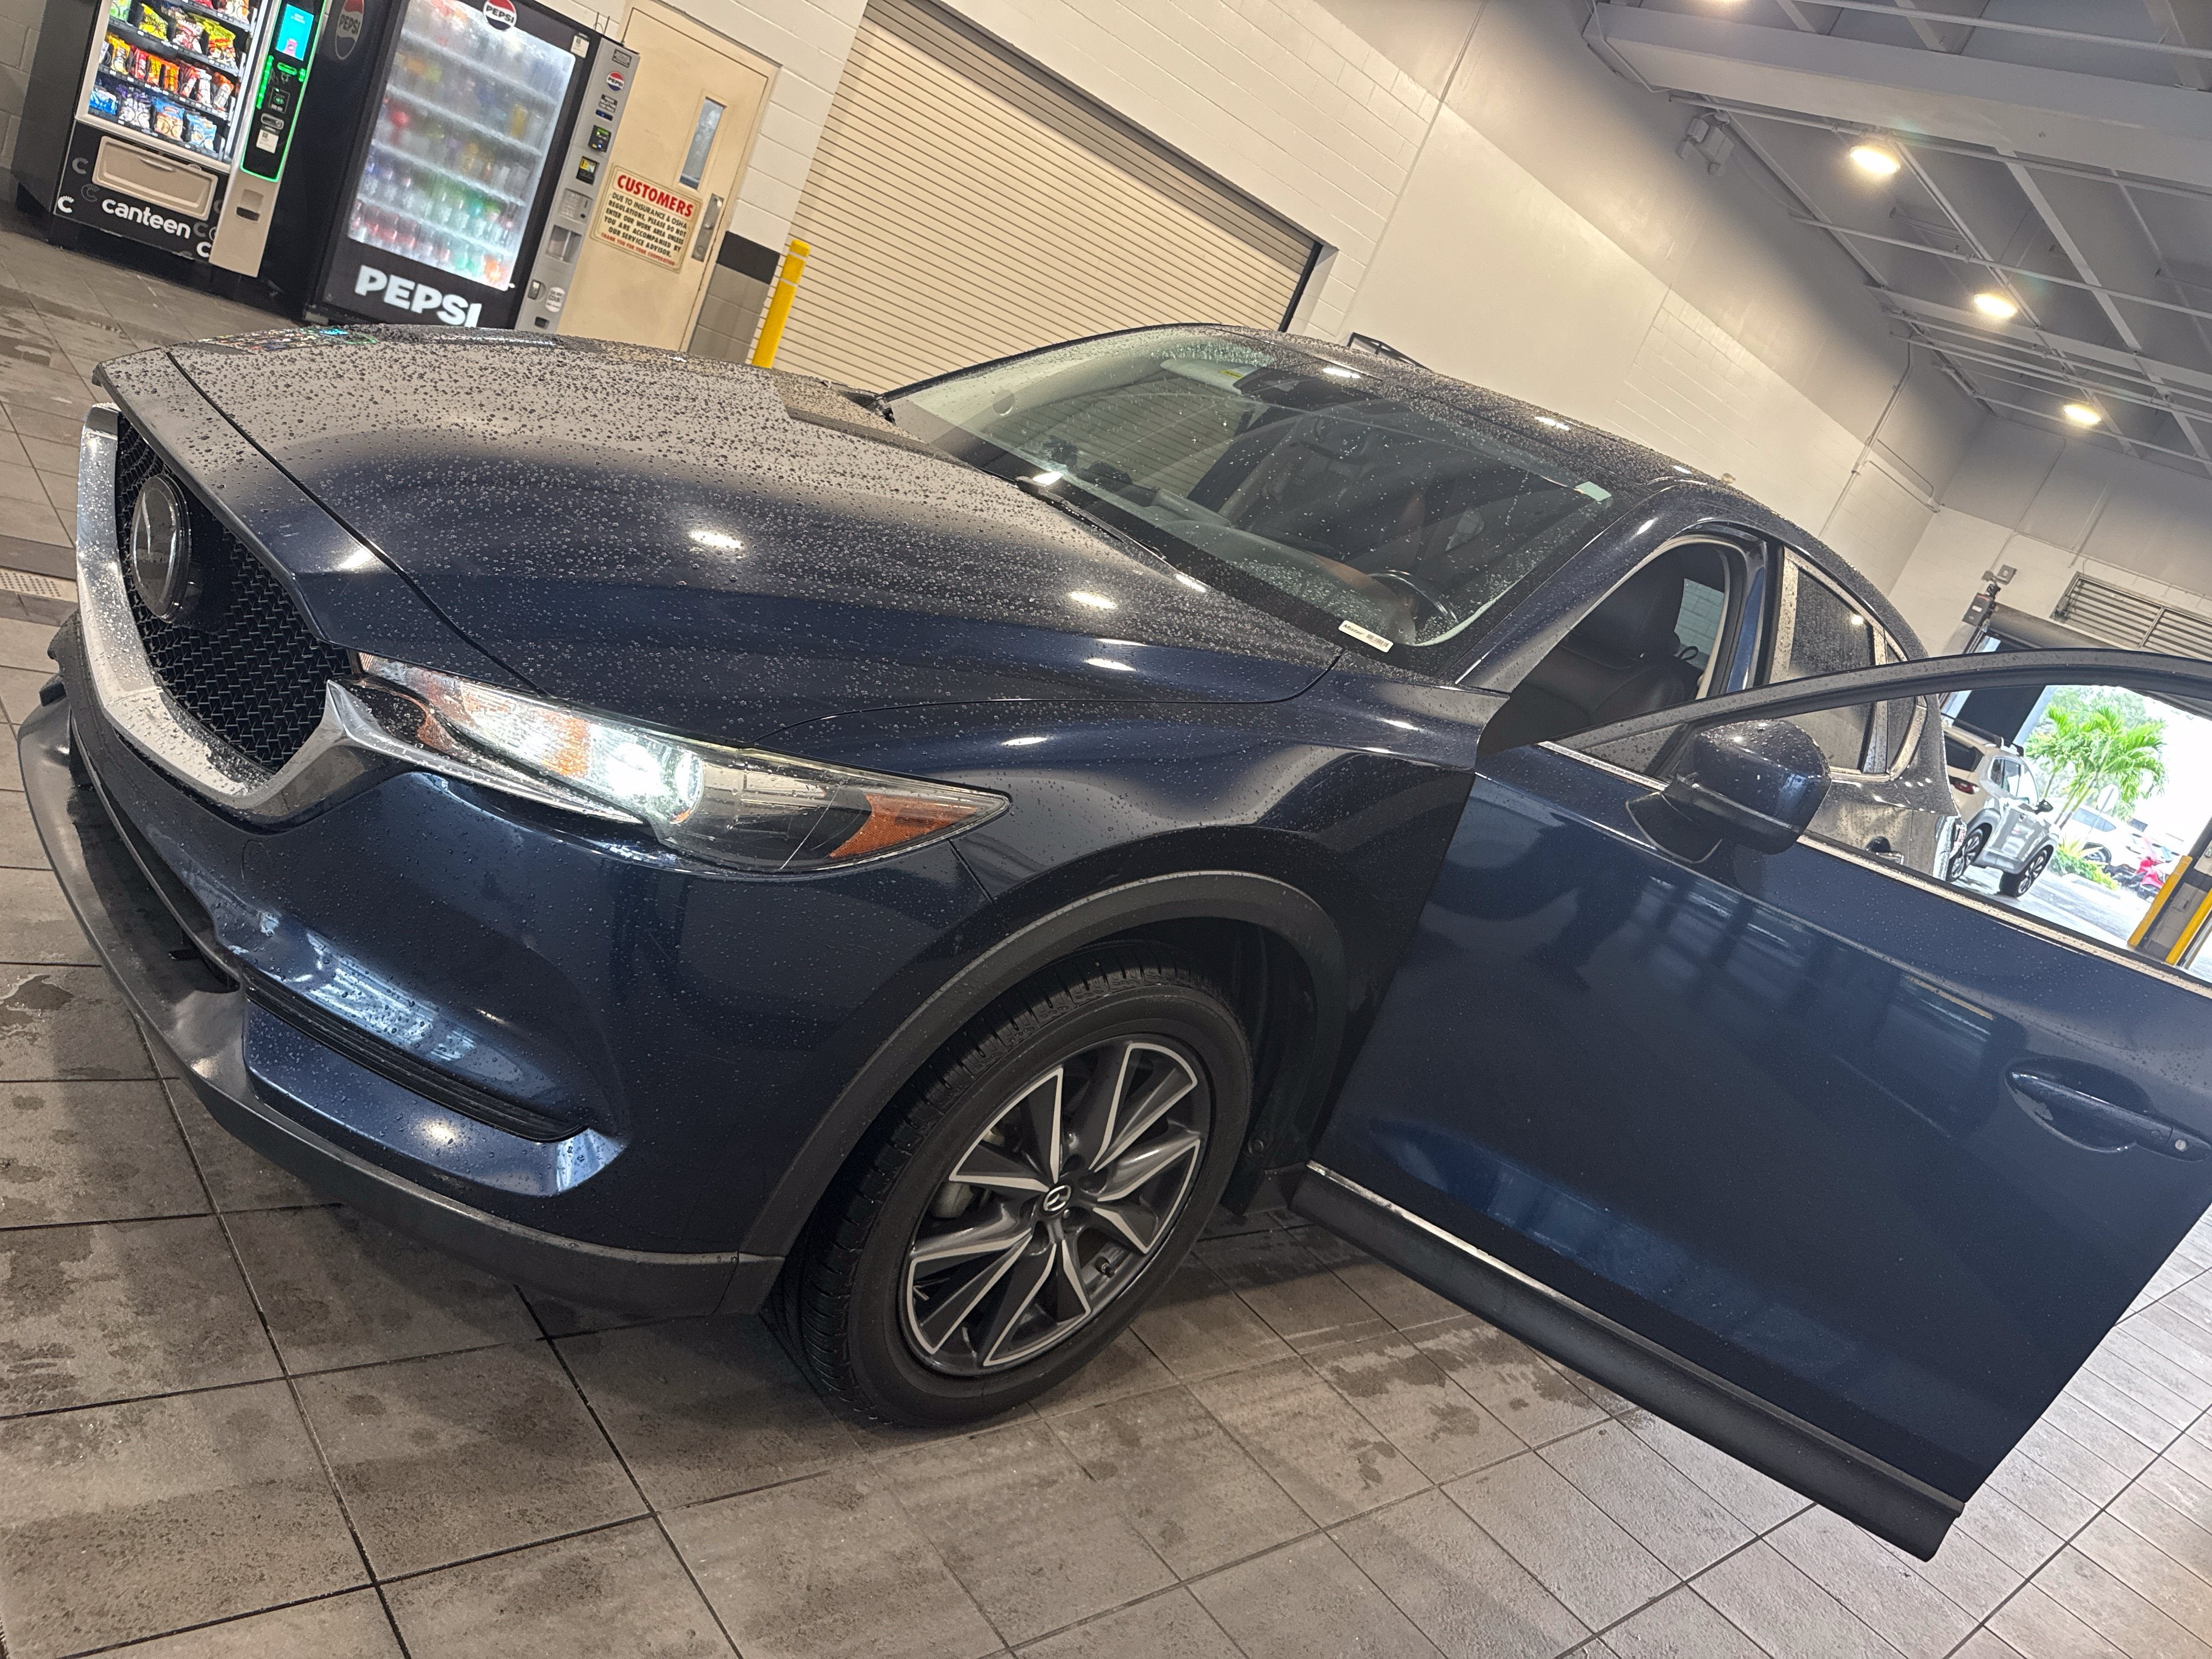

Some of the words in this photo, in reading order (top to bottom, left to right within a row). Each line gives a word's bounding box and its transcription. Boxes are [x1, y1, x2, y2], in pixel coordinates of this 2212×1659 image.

[338, 14, 361, 35] PEPSI
[486, 5, 515, 23] PEPSI
[607, 76, 623, 87] PEPSI
[612, 192, 624, 202] DUE
[625, 198, 633, 206] TO
[634, 201, 666, 220] INSURANCE
[672, 218, 687, 229] OSHA
[618, 174, 693, 217] CUSTOMERS
[102, 199, 191, 239] canteen
[604, 216, 617, 225] YOU
[618, 222, 630, 232] ARE
[632, 228, 672, 249] ACCOMPANIED
[606, 208, 622, 219] ENTER
[623, 215, 635, 224] OUR
[636, 220, 652, 231] WORK
[653, 228, 666, 238] AREA
[667, 234, 684, 245] UNLESS
[608, 200, 646, 222] REGULATIONS,
[647, 216, 666, 229] PLEASE
[667, 224, 675, 233] DO
[675, 228, 687, 238] NOT
[608, 227, 621, 236] OUR
[622, 232, 645, 246] SERVICE
[645, 242, 672, 257] ADVISOR.
[354, 264, 482, 328] PEPSI
